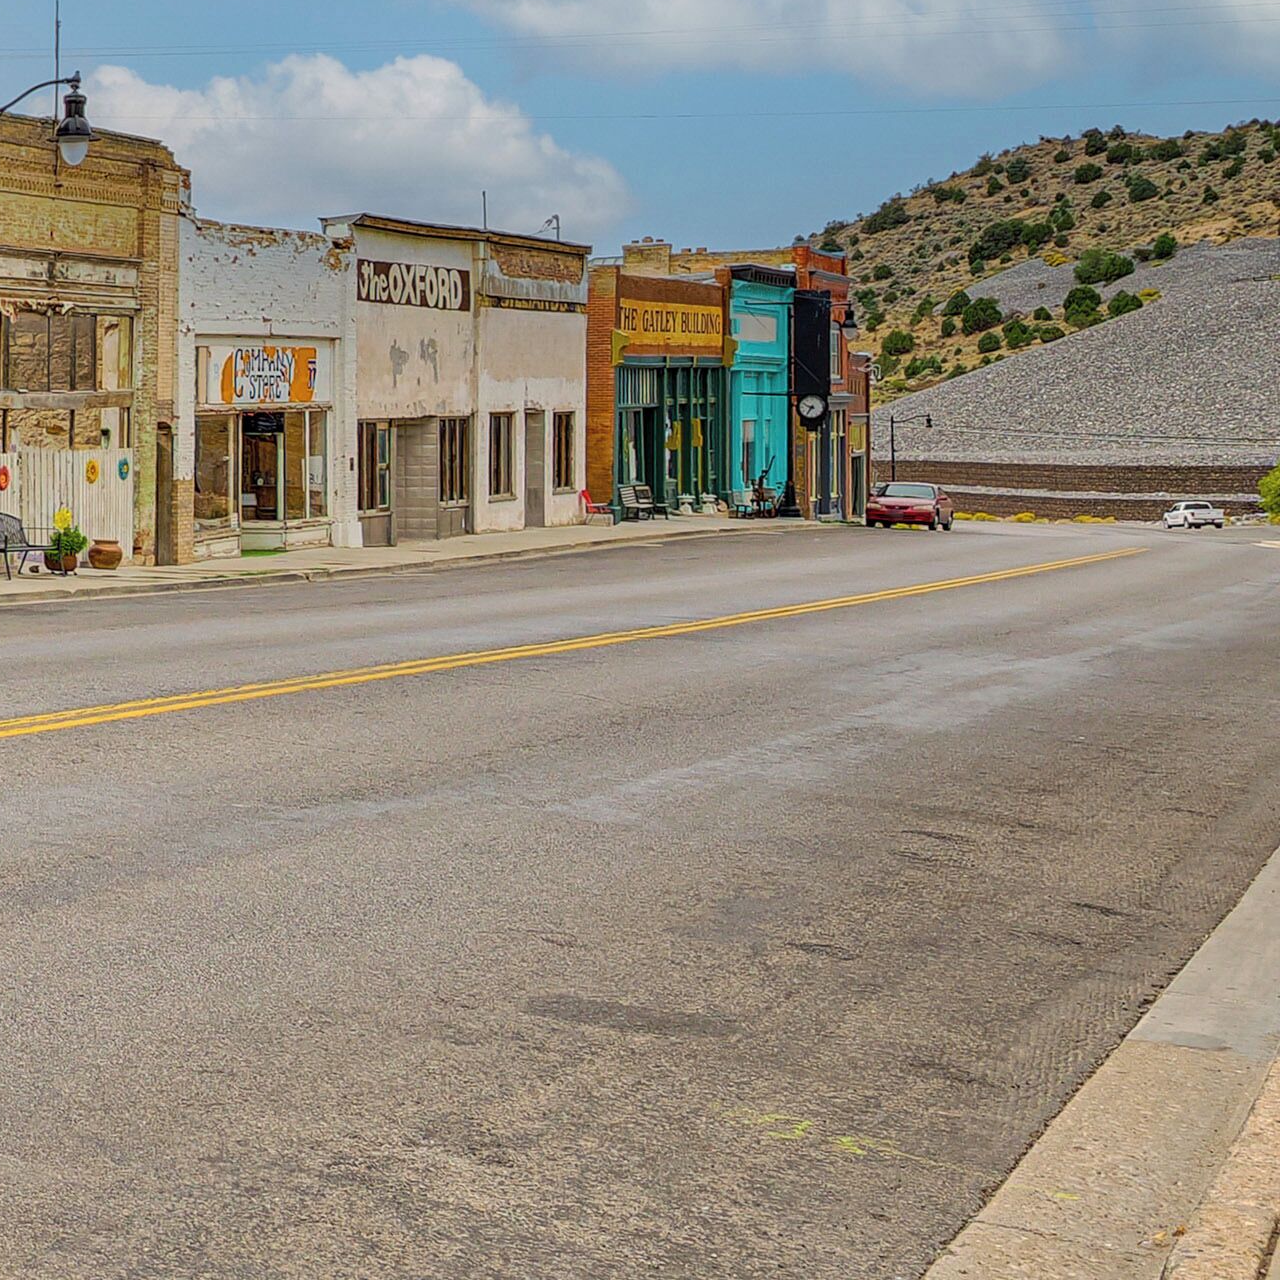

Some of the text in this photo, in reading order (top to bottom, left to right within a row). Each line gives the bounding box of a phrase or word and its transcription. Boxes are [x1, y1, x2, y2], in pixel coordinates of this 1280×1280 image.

[359, 260, 389, 302] the
[389, 263, 463, 310] OXFORD
[620, 306, 722, 335] THE GATLEY BUILDING
